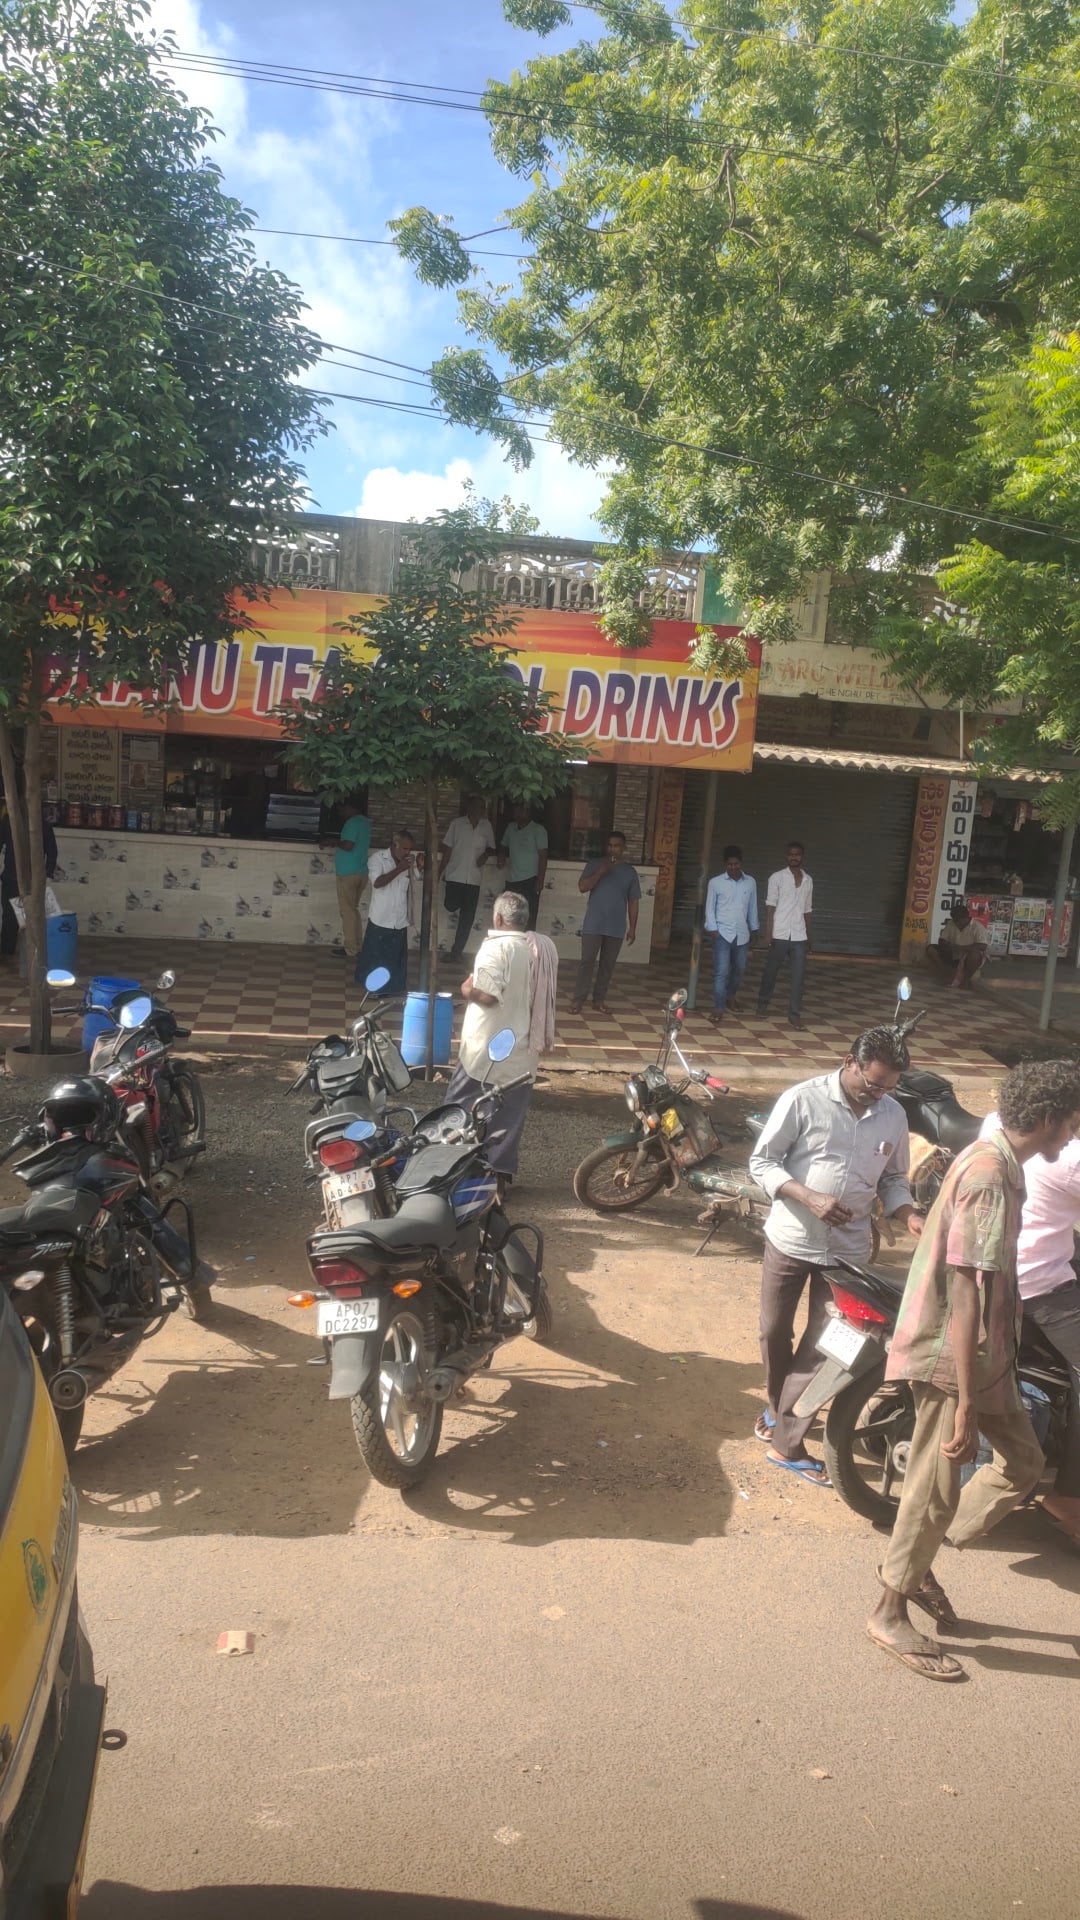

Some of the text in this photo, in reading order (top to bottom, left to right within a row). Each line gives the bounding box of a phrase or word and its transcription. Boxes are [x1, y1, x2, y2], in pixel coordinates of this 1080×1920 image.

[777, 657, 825, 683] ARC
[562, 668, 742, 750] DRINKS
[336, 1301, 370, 1318] AP07
[325, 1314, 376, 1334] DC2297
